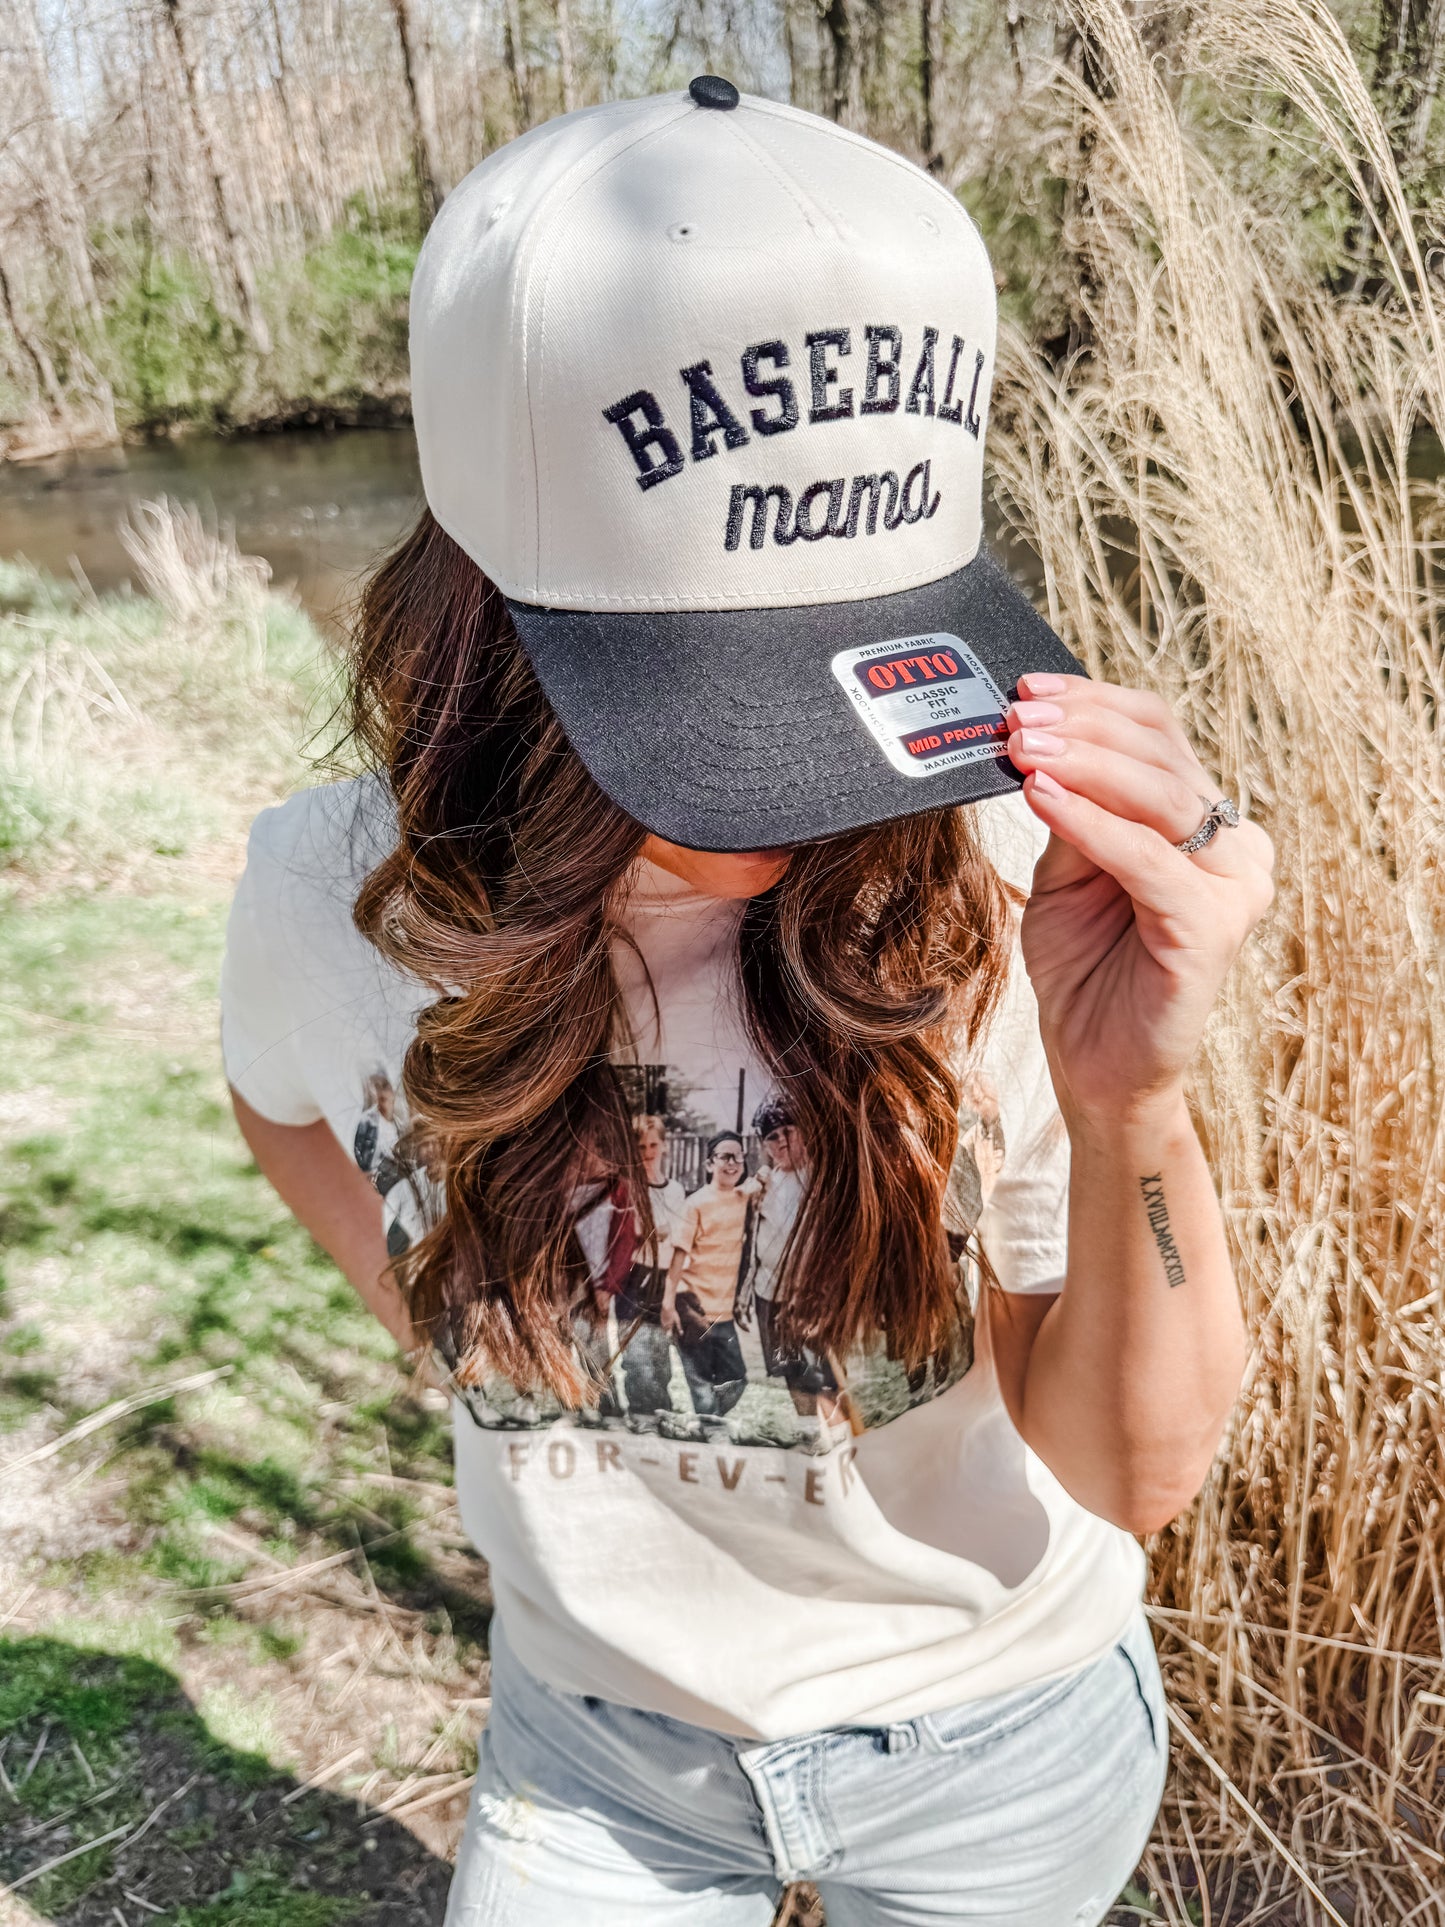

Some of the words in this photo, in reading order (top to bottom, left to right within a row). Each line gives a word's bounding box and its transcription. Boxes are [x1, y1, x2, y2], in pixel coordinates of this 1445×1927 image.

[601, 324, 983, 492] BASEBALL
[724, 459, 941, 551] mama
[859, 643, 904, 659] PREMIUM
[905, 637, 936, 649] FABRIC
[867, 652, 959, 690] OTTO
[963, 653, 984, 680] MOST
[905, 686, 959, 704] CLASSIC
[928, 698, 948, 709] FIT
[930, 707, 961, 720] OSFM
[908, 735, 942, 755] MID
[943, 721, 1008, 744] PROFILE
[924, 751, 976, 771] MAXIMUM
[977, 743, 1008, 757] COMFO
